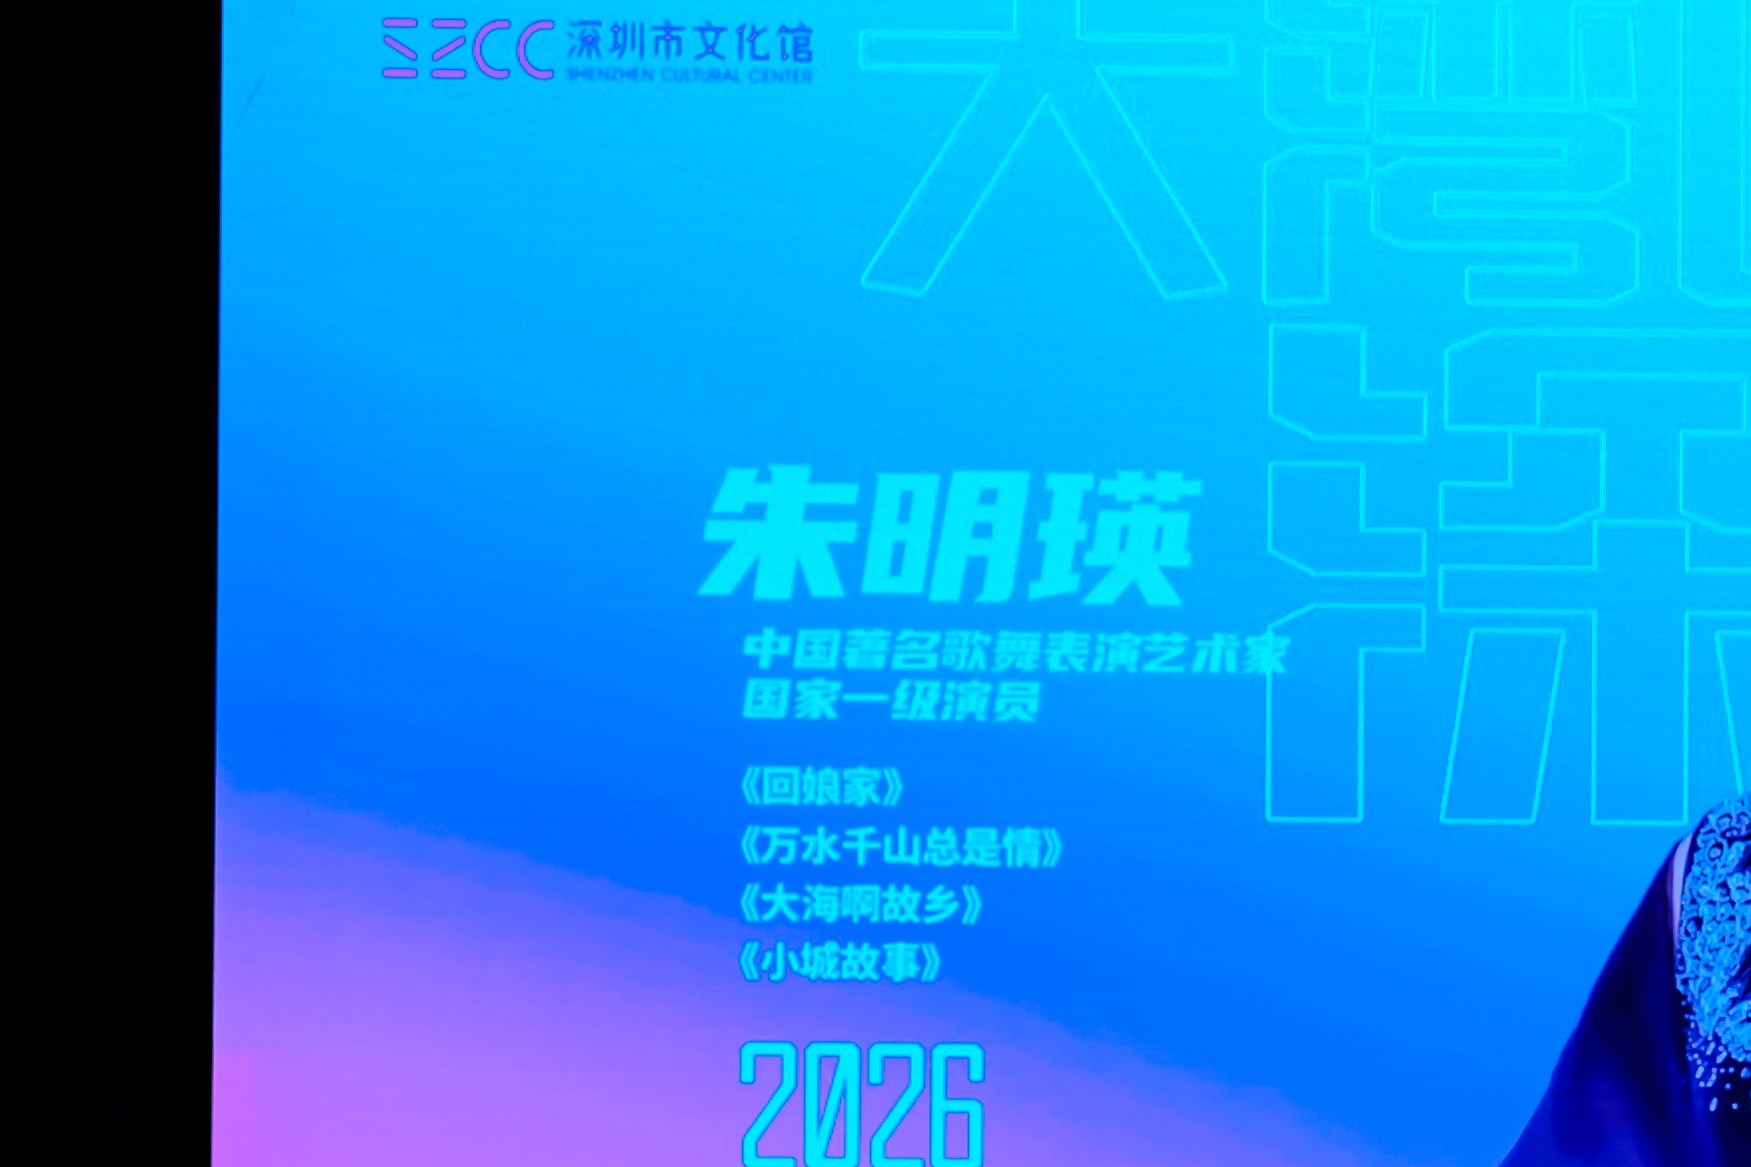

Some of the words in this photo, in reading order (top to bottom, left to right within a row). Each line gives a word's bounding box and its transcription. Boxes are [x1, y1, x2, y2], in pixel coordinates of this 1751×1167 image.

[566, 19, 813, 63] 深圳市文化馆
[697, 464, 1202, 605] 朱明瑛
[742, 627, 1291, 674] 中国著名歌舞表演艺术家
[742, 678, 1042, 722] 国家一级演员
[741, 766, 903, 807] 《回娘家》
[740, 825, 1063, 868] 《万水千山总是情》
[740, 882, 983, 925] 《大海啊故乡》
[738, 940, 942, 983] 《小城故事》
